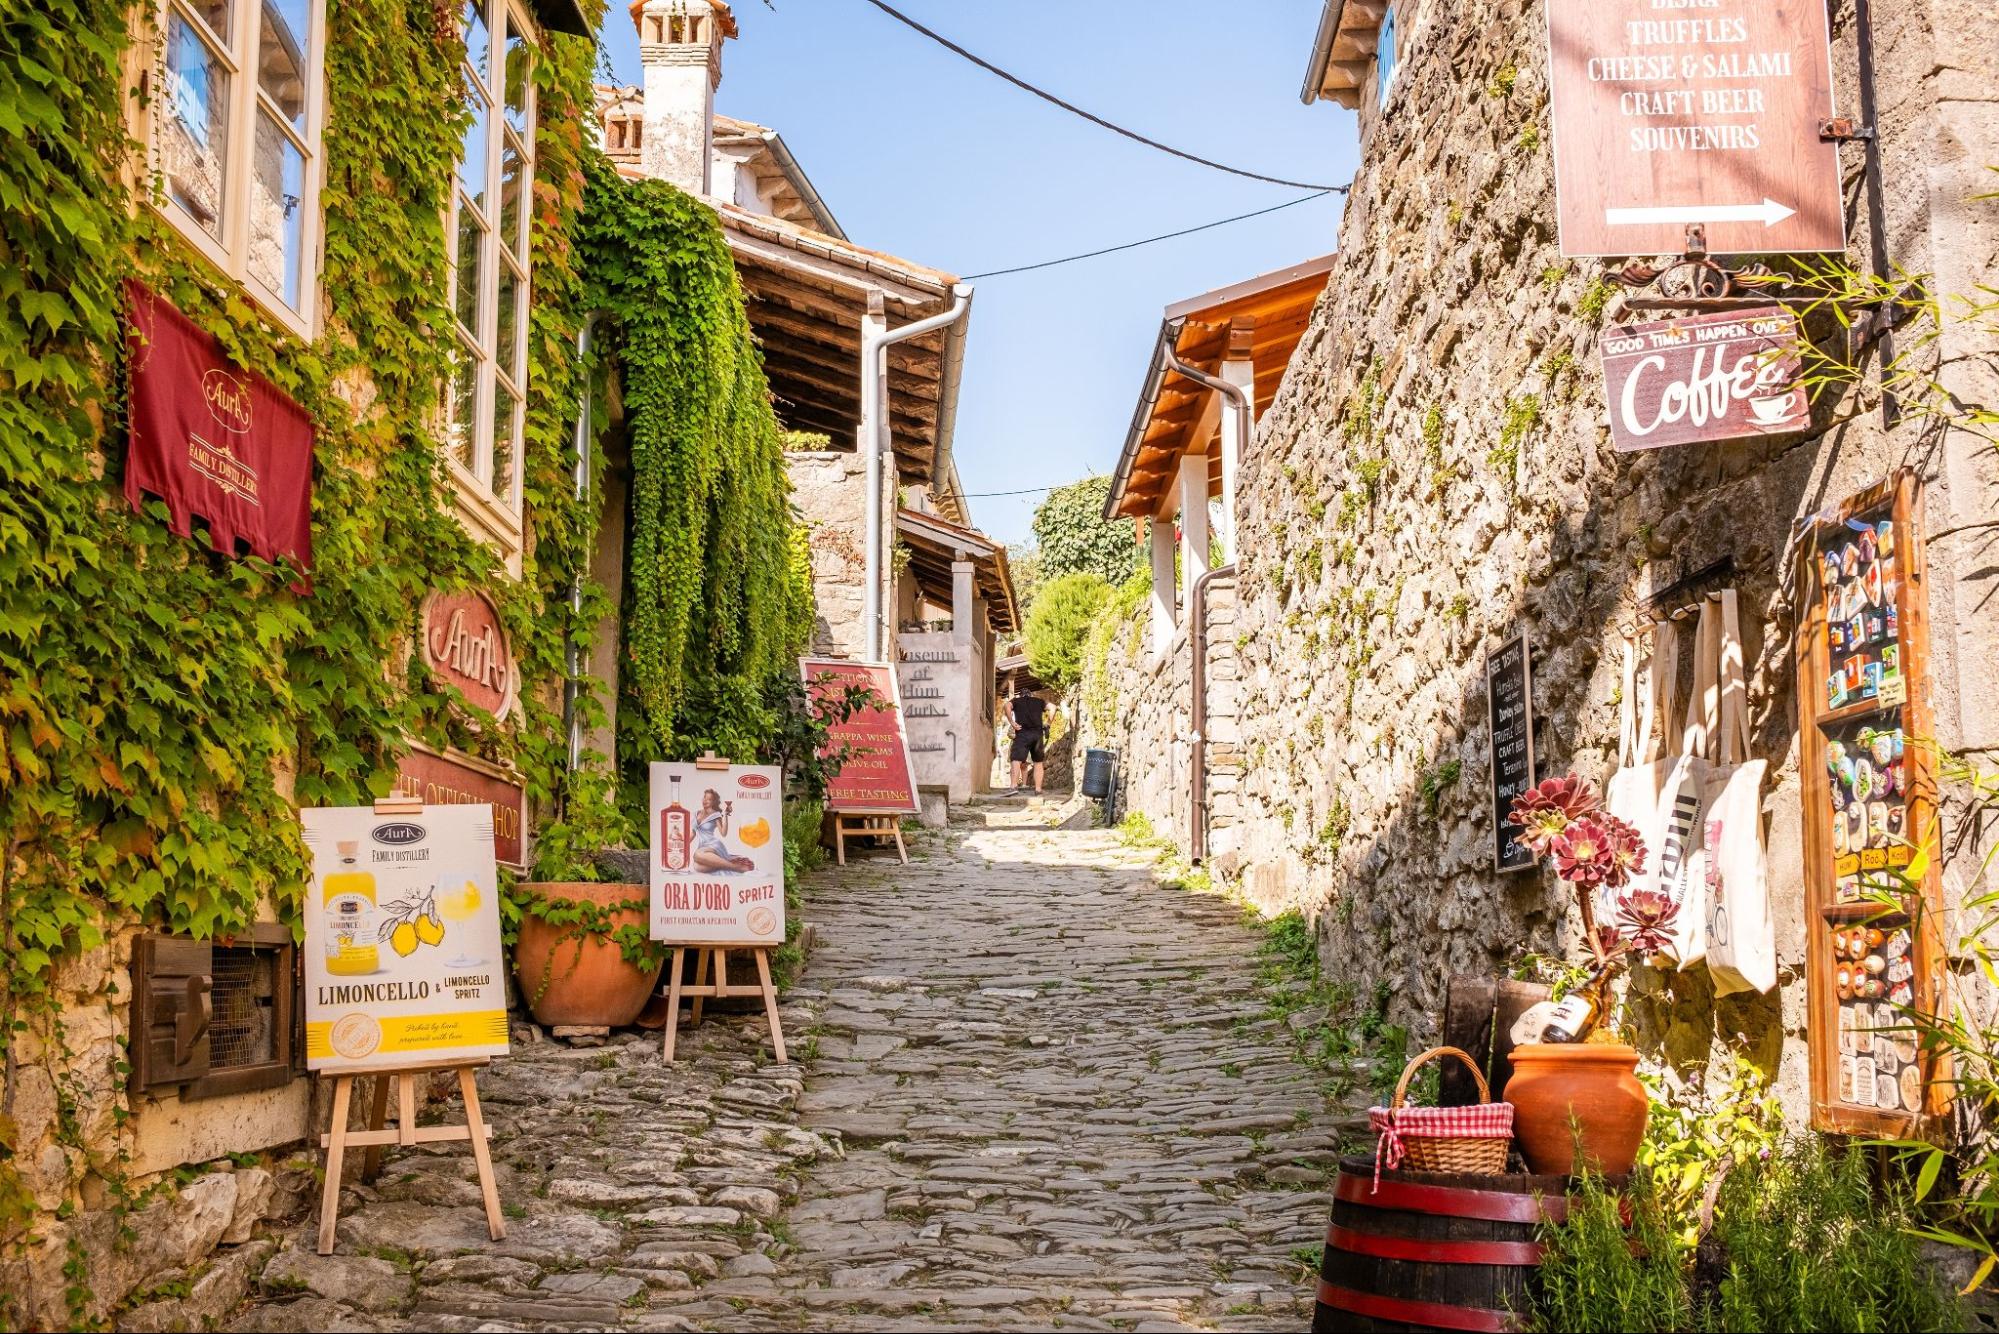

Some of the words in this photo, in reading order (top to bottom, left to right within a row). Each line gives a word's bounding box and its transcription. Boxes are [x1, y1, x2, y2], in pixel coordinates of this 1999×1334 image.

[1626, 16, 1747, 46] TRUFFLES
[1587, 54, 1677, 82] CHEESE
[1681, 54, 1699, 78] &
[1702, 51, 1793, 79] SALAMI
[1620, 90, 1695, 117] CRAFT
[1702, 88, 1765, 115] BEER
[1630, 123, 1760, 153] SOUVENIRS
[1605, 337, 1645, 356] GOOD
[1649, 330, 1690, 348] TIMES
[1696, 323, 1748, 343] HAPPEN
[189, 442, 217, 472] FAMILY
[218, 459, 259, 497] DISTILLERY
[913, 665, 930, 679] of
[866, 733, 894, 743] WINE
[1499, 743, 1515, 758] CRAFT
[871, 760, 889, 769] OIL
[396, 773, 420, 799] HE
[491, 801, 520, 841] HOP
[830, 788, 856, 799] FREE
[857, 788, 909, 800] TASTING
[664, 882, 690, 910] ORA
[693, 882, 731, 911] D'ORO
[738, 884, 775, 905] SPRITZ
[318, 980, 430, 1006] LIMONCELLO
[435, 982, 442, 993] &
[443, 974, 491, 988] LIMONCELLO
[454, 987, 481, 1000] SPRITZ
